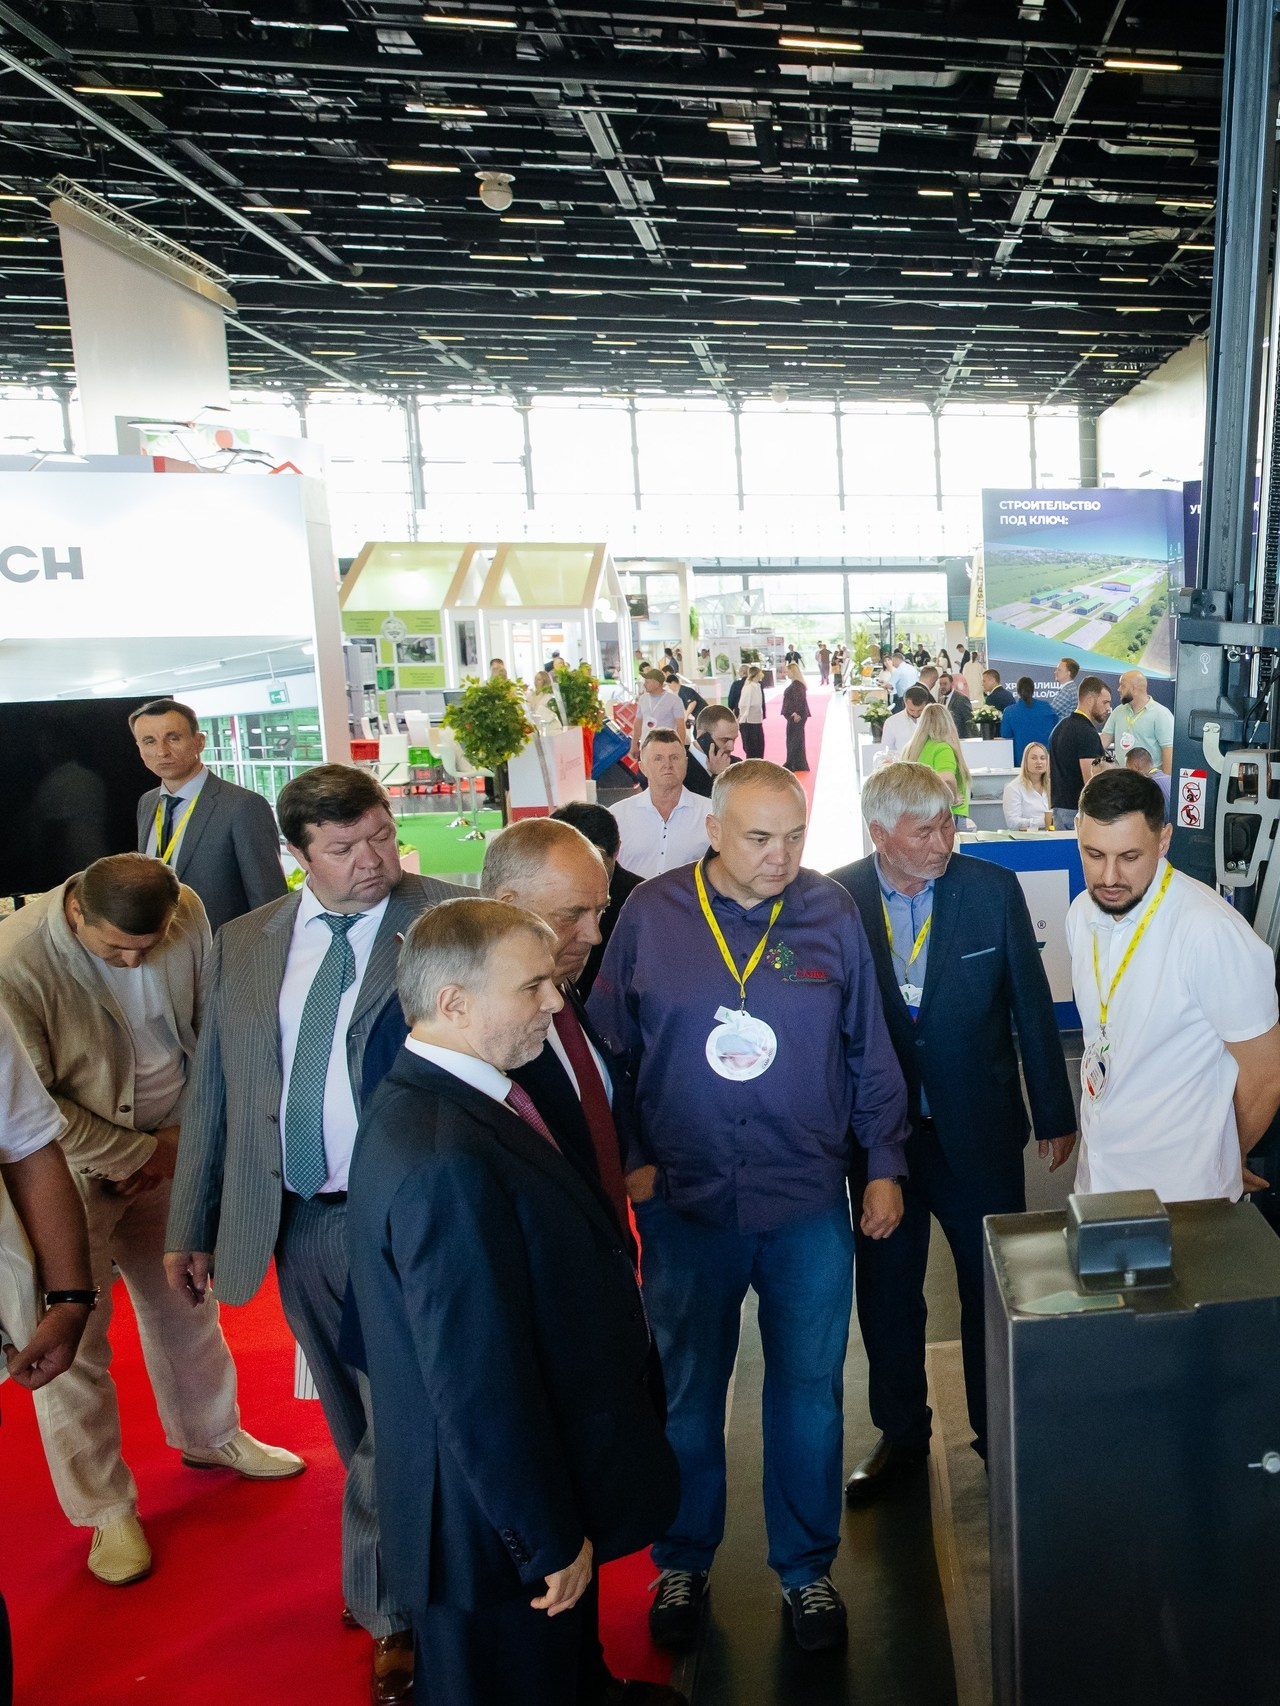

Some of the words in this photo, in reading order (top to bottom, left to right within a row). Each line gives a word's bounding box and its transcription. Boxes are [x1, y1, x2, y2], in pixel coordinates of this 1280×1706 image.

[999, 500, 1102, 511] СТРОИТЕЛЬСТВО
[1000, 515, 1027, 526] ПОД
[1029, 515, 1069, 525] КЛЮЧ:
